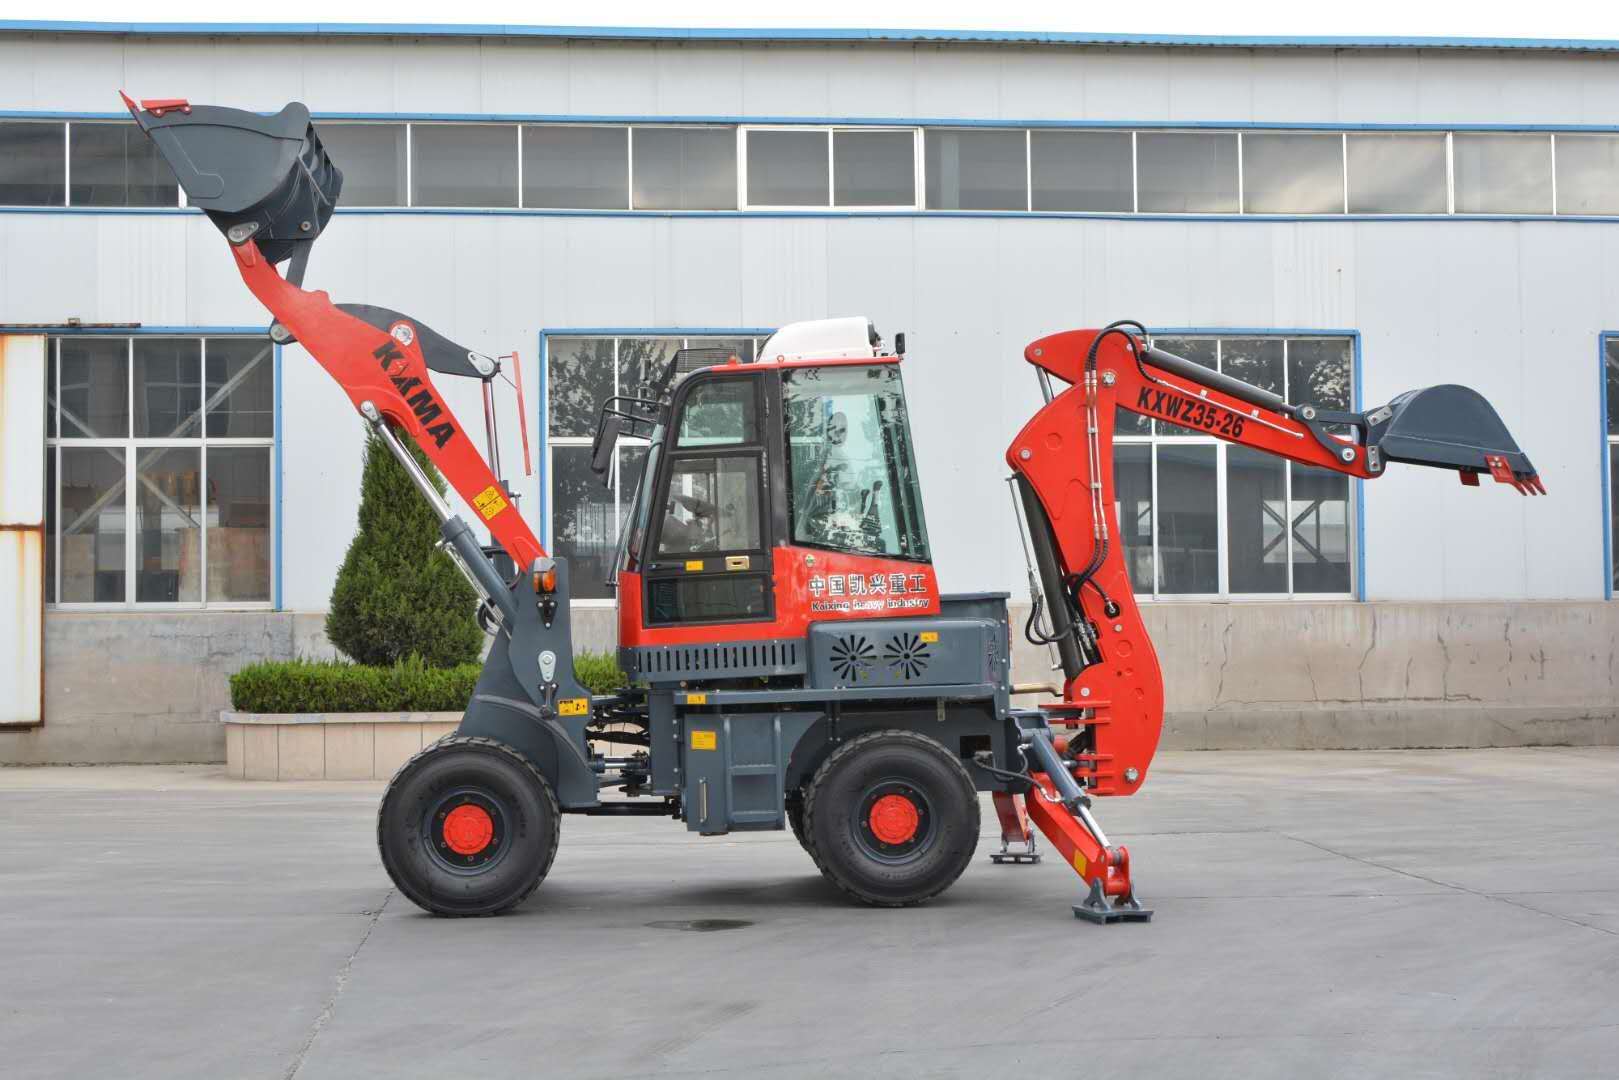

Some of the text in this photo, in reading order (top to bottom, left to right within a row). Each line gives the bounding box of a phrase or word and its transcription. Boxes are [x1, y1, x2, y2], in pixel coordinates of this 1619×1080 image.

[1137, 386, 1245, 438] KXWZ35-26
[809, 572, 927, 597] 中国凯兴重工
[811, 600, 850, 613] Kaixing
